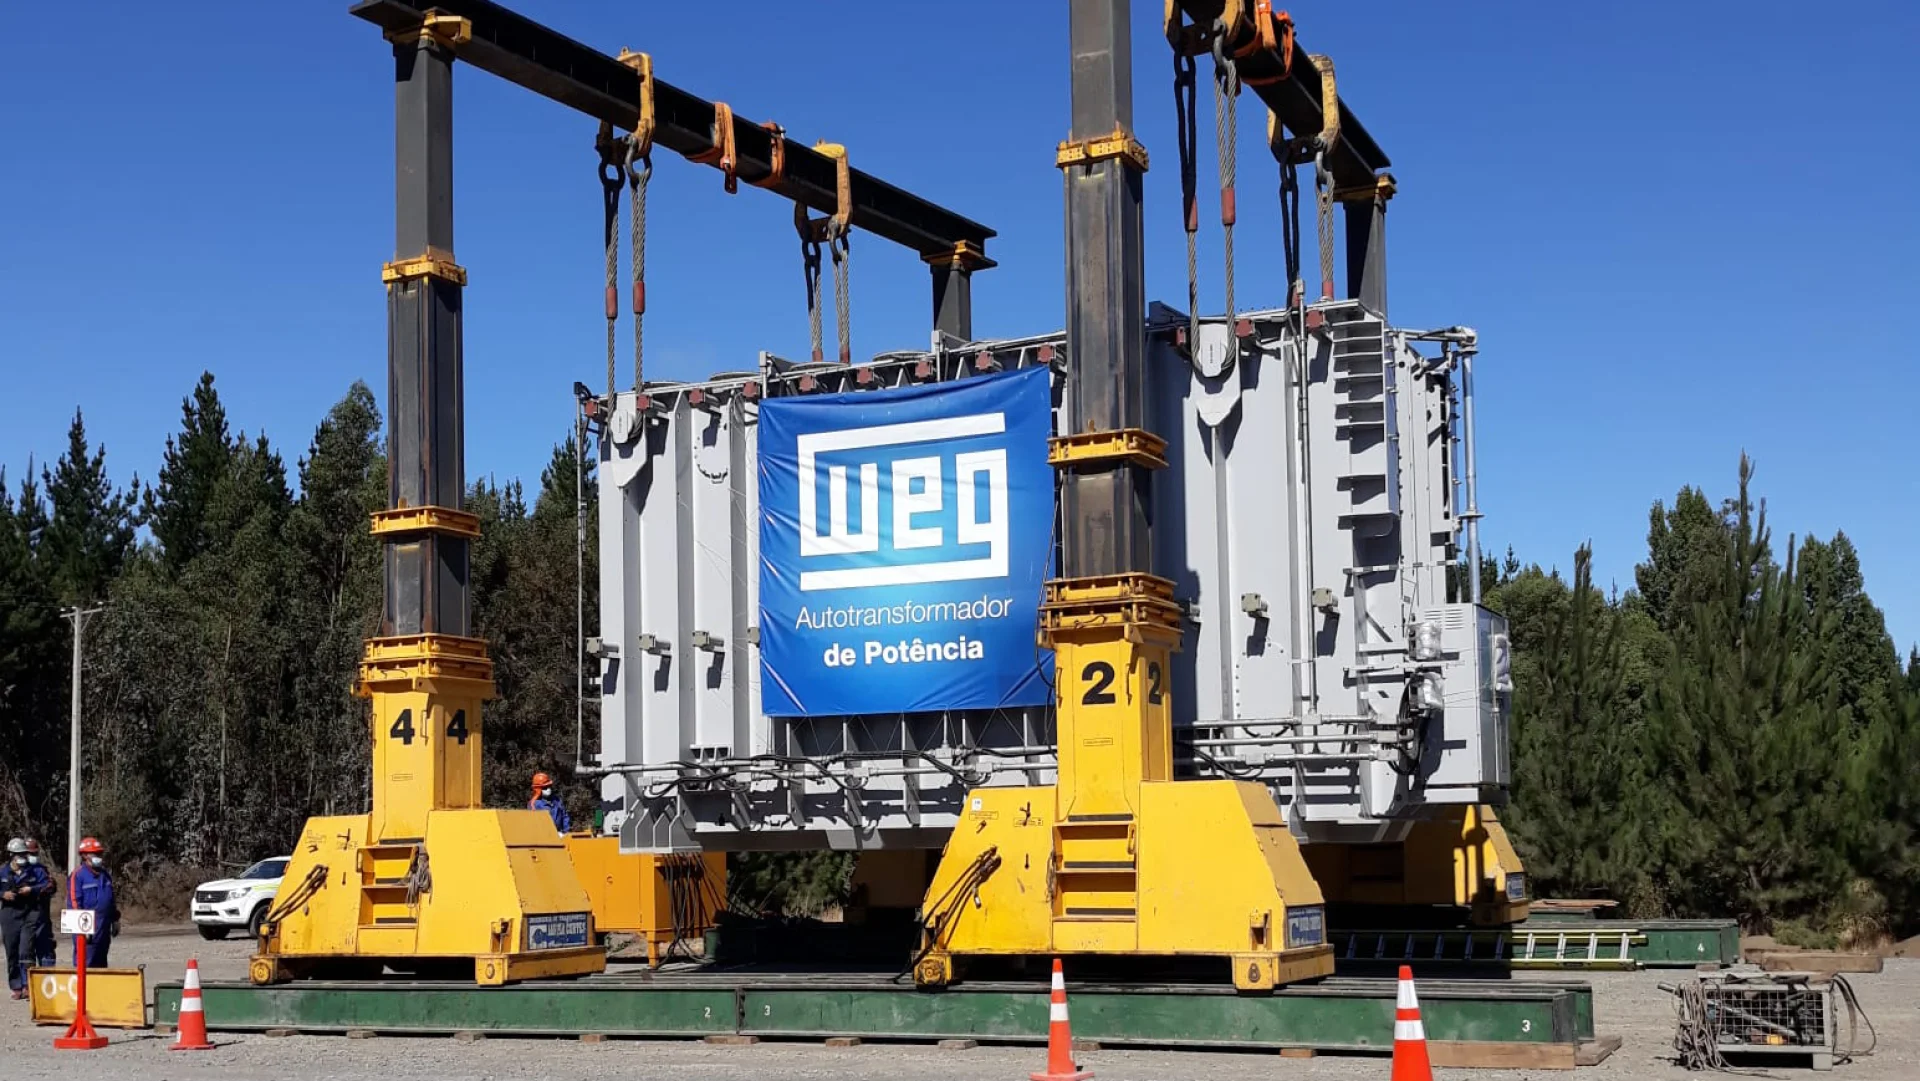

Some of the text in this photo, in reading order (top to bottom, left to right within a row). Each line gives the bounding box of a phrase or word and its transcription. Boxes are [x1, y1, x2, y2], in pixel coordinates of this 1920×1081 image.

[796, 594, 1013, 630] Autotransformador
[823, 635, 984, 667] de Potência
[1081, 661, 1116, 705] 2
[1148, 661, 1163, 705] 2
[390, 708, 415, 745] 4
[446, 708, 469, 745] 4
[171, 1002, 178, 1012] 2
[704, 1006, 712, 1018] 2
[764, 1004, 772, 1016] 3
[1522, 1019, 1531, 1032] 3
